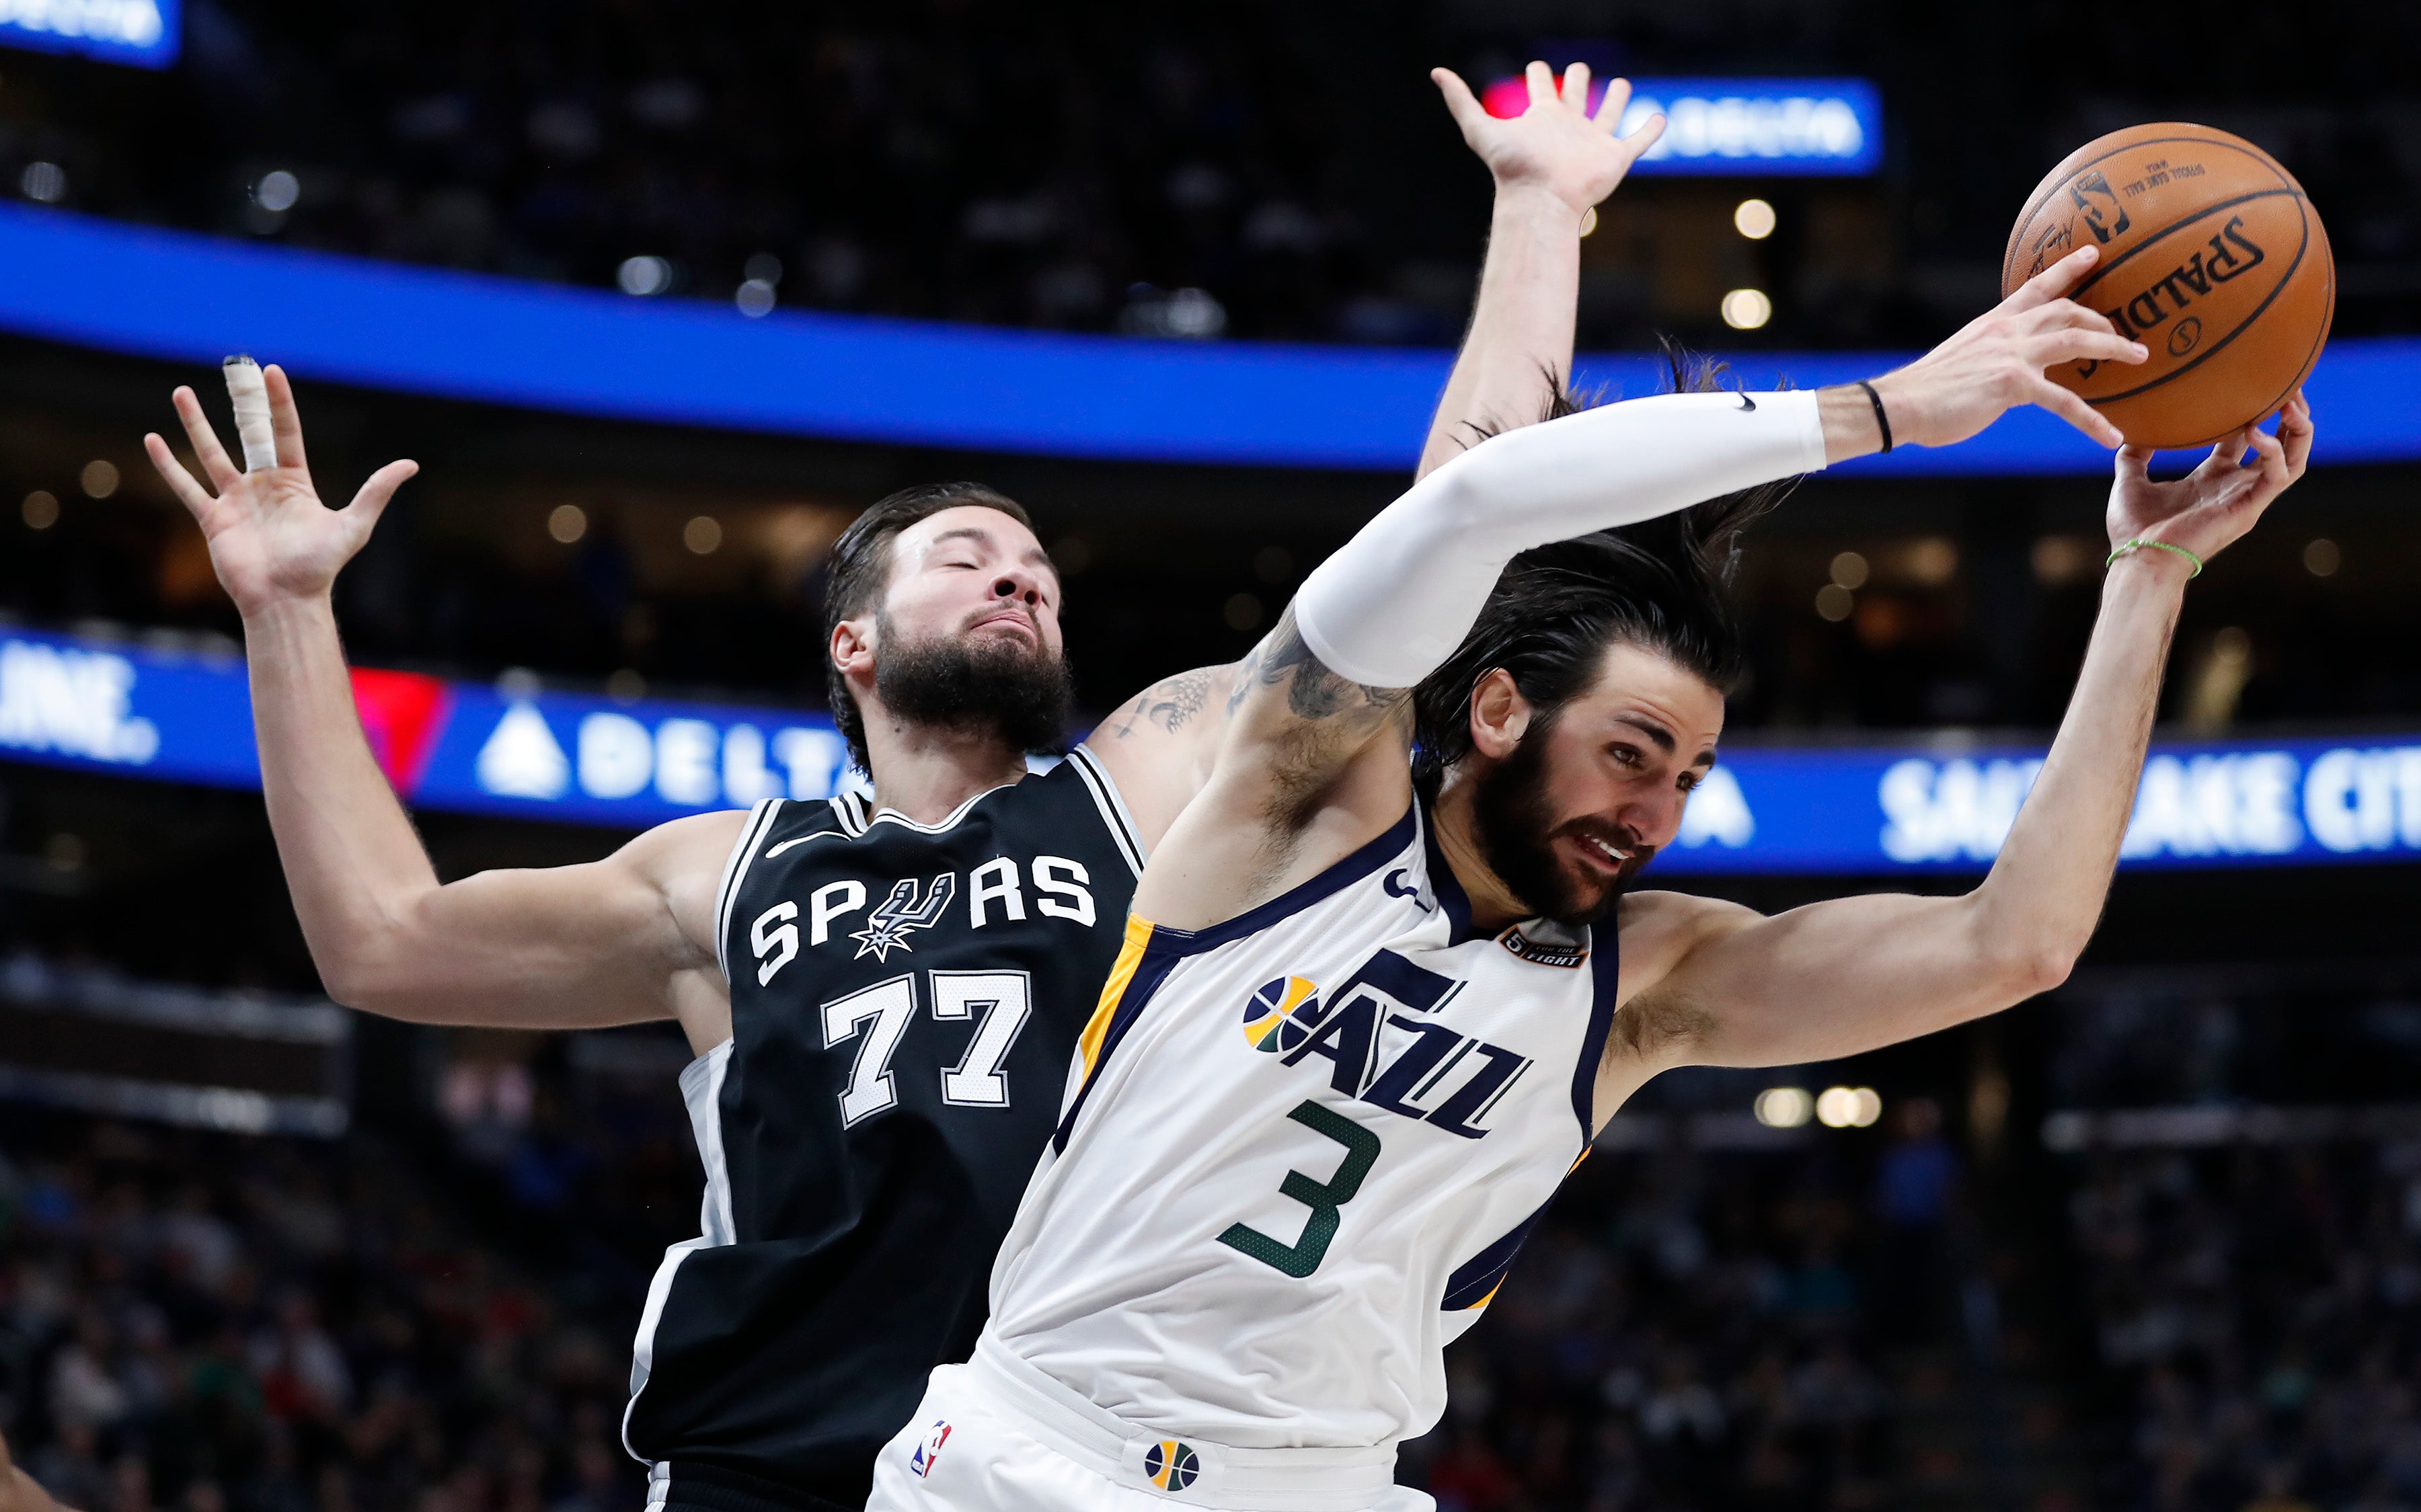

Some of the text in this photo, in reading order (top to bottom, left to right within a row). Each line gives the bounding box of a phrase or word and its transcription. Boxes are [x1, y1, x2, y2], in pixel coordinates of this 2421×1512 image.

[2079, 215, 2264, 381] SPALDI
[1879, 758, 2047, 863] SAL
[2118, 753, 2304, 858] AKE
[751, 854, 1096, 986] SPURS
[1527, 953, 1580, 967] FIGHT
[818, 968, 1033, 1131] 77
[1244, 947, 1535, 1140] JAZZ
[1215, 1099, 1382, 1279] 3
